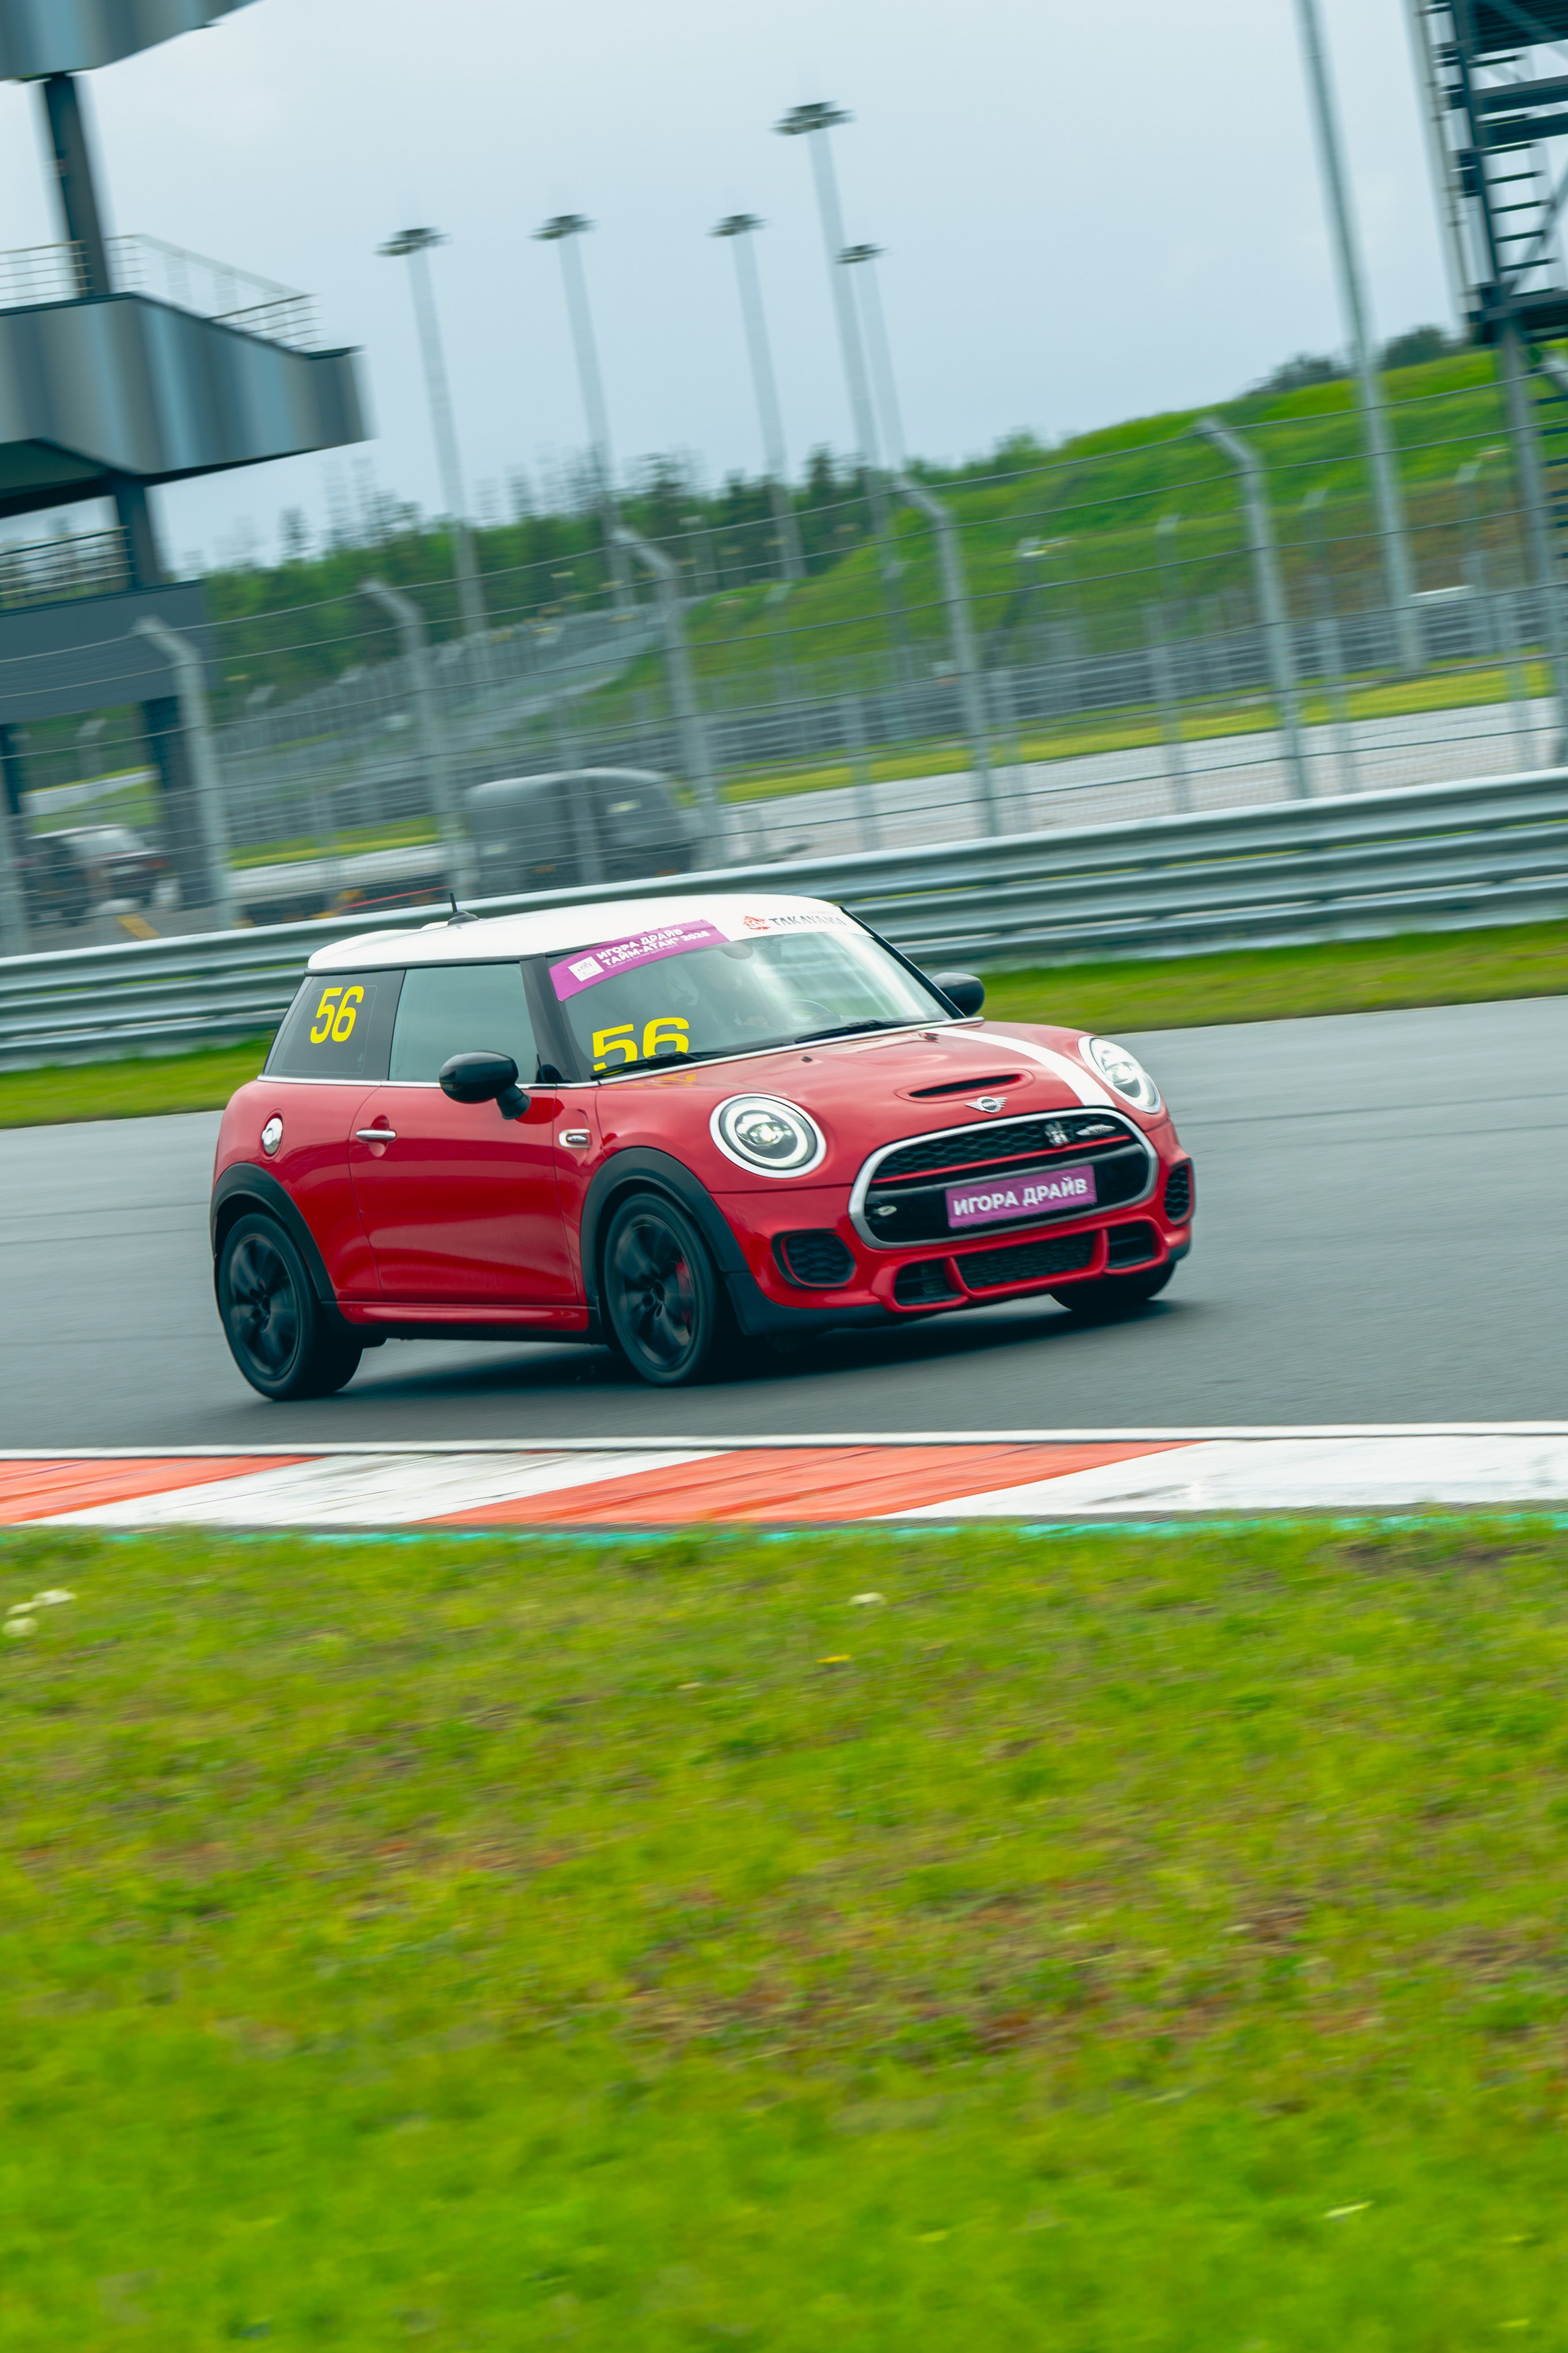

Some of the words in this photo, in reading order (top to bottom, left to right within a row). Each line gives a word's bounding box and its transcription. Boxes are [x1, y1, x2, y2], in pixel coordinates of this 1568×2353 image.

[769, 916, 847, 926] TAKAYAMA
[595, 941, 640, 961] ИГОРА
[639, 929, 684, 945] ДРАЙВ
[310, 986, 364, 1044] 56
[592, 1017, 690, 1072] 56
[953, 1191, 1020, 1216] ИГОРА
[1022, 1176, 1088, 1207] ДРАЙВ
